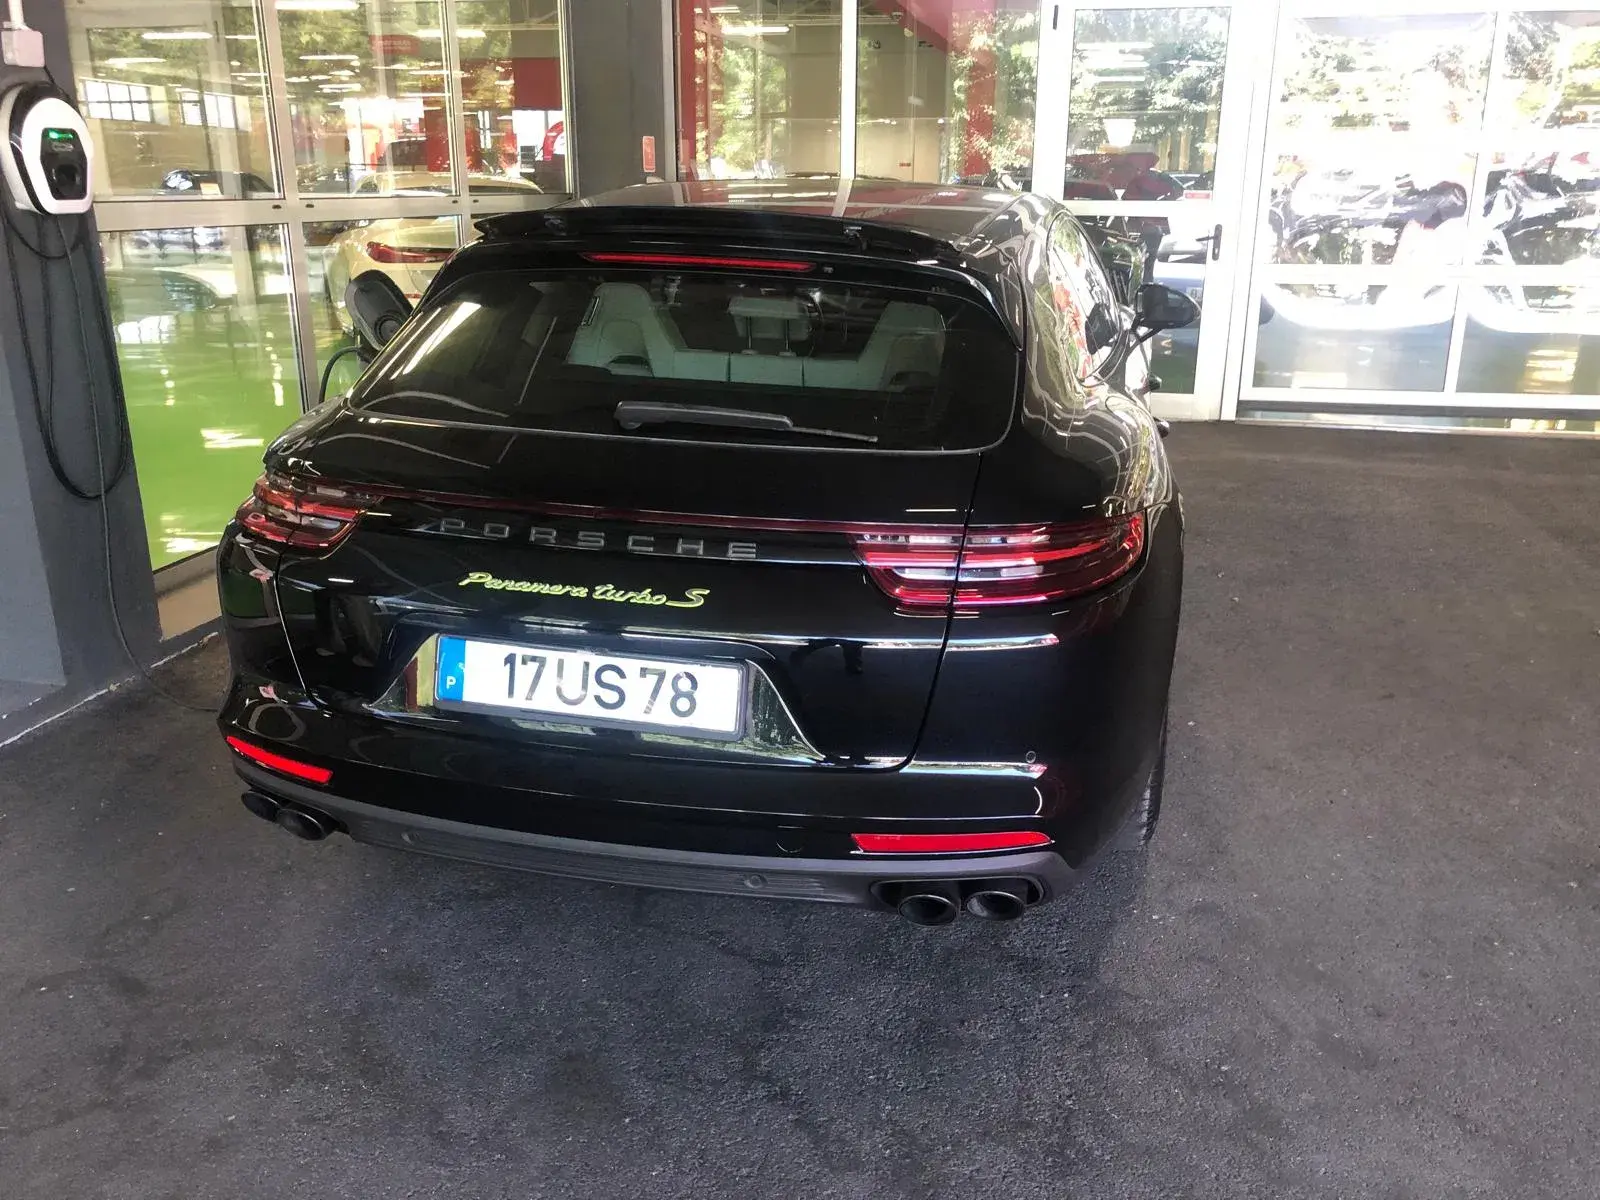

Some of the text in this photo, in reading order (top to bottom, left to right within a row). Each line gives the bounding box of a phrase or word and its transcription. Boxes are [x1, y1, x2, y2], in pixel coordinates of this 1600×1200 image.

[440, 518, 757, 559] PORSCHE
[458, 571, 710, 608] Panamera turbo S
[446, 675, 457, 690] P
